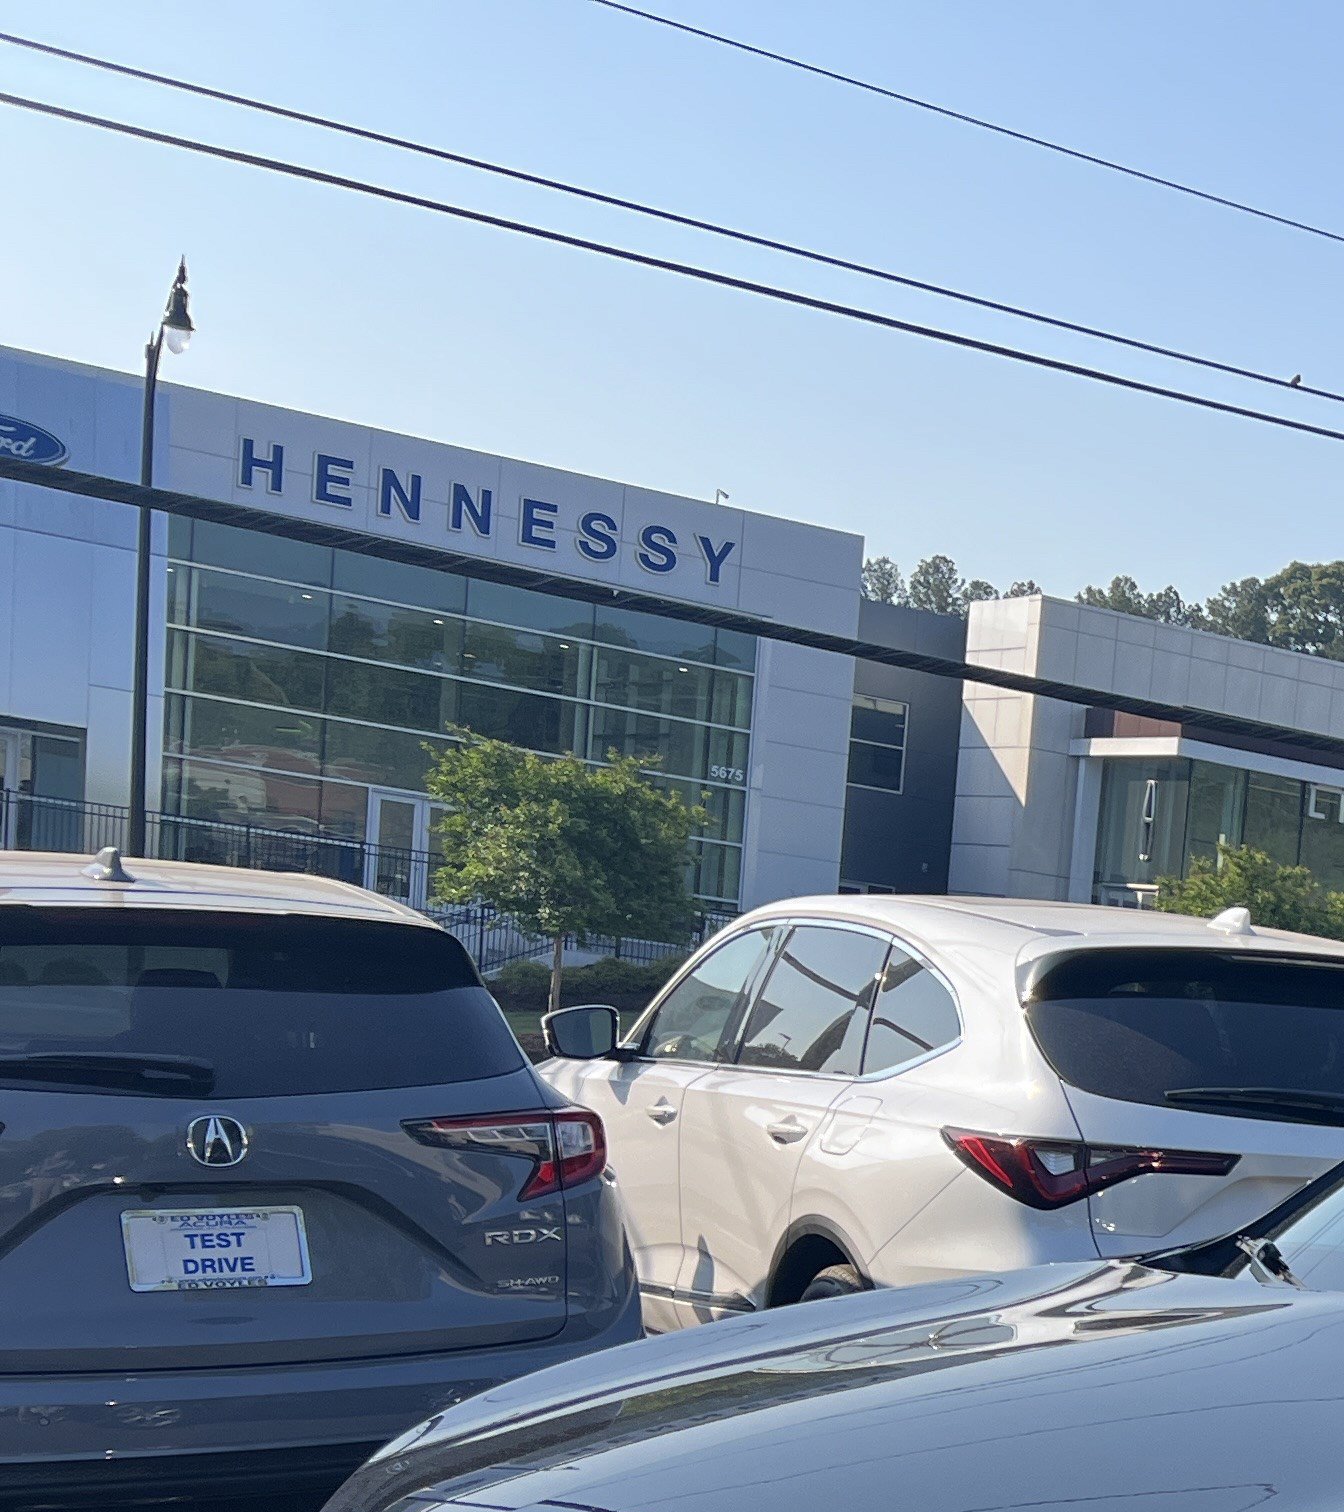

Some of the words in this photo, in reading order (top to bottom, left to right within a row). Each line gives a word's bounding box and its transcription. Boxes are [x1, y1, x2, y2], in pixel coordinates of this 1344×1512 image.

[238, 436, 737, 586] HENNESSY
[710, 765, 744, 782] 5675
[184, 1232, 245, 1249] TEST
[484, 1227, 562, 1246] RDX
[182, 1256, 255, 1275] DRIVE
[496, 1275, 560, 1288] SH-AWD
